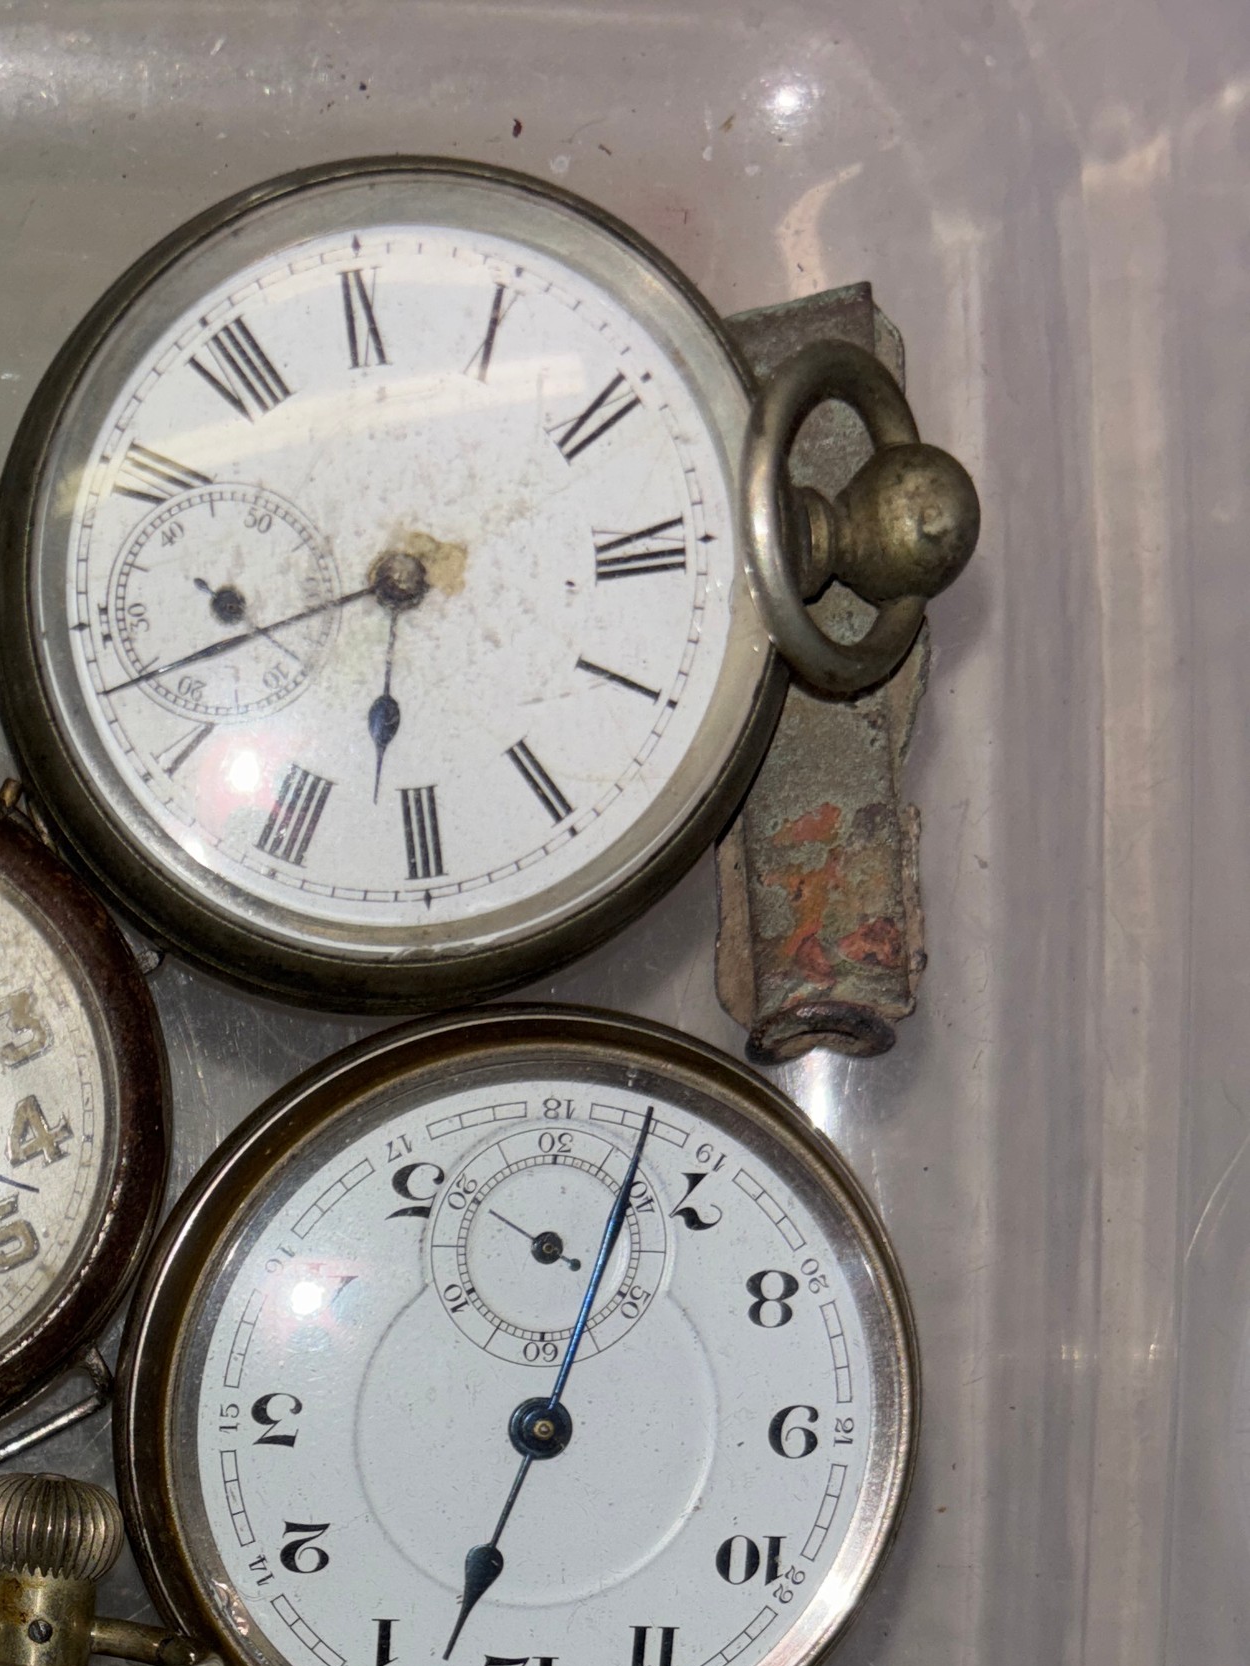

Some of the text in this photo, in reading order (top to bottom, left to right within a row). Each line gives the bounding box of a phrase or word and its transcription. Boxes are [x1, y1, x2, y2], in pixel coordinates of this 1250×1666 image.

[160, 521, 186, 549] 40
[243, 506, 273, 534] 50
[127, 602, 150, 633] 30
[542, 1097, 576, 1120] 18
[4, 1093, 77, 1168] 4
[385, 1132, 415, 1164] 17
[538, 1132, 574, 1153] 30
[695, 1142, 731, 1172] 19
[385, 1162, 445, 1220] 5
[447, 1173, 478, 1210] 20
[669, 1172, 724, 1232] 7
[800, 1257, 830, 1295] 20
[443, 1283, 472, 1315] 10
[620, 1284, 651, 1320] 50
[745, 1268, 800, 1328] 8
[523, 1342, 559, 1362] 60
[219, 1403, 239, 1435] 15
[251, 1391, 304, 1449] 3
[767, 1403, 819, 1459] 9
[833, 1416, 854, 1449] 21
[279, 1521, 331, 1574] 2
[715, 1534, 787, 1585] 10
[248, 1553, 278, 1587] 14
[772, 1563, 807, 1605] 22
